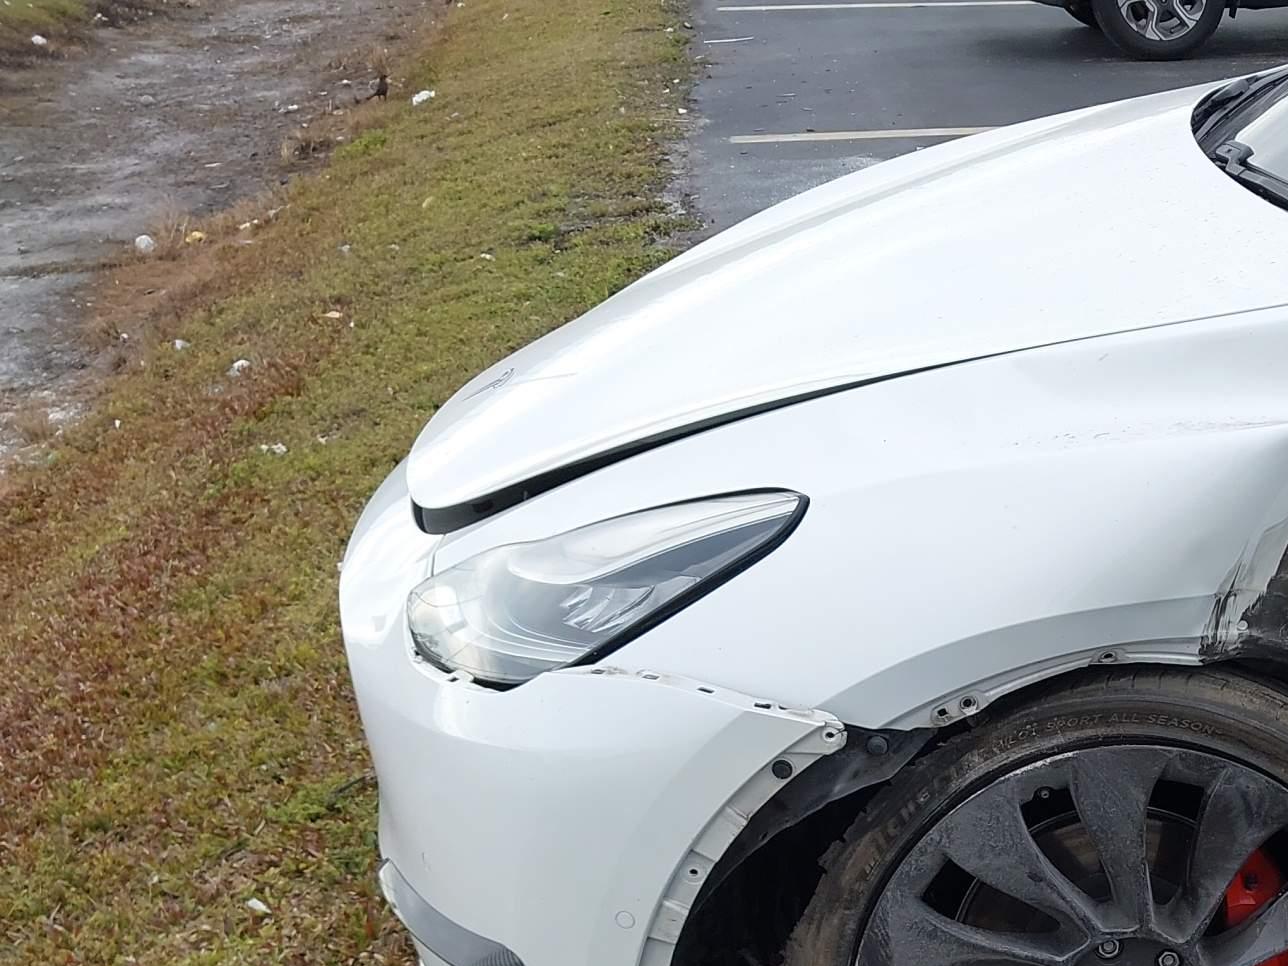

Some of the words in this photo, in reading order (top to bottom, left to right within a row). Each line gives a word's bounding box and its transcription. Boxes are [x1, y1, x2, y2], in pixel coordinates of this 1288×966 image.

[1047, 713, 1104, 732] SPORT
[1108, 712, 1141, 724] ALL
[1147, 713, 1216, 736] SEASON
